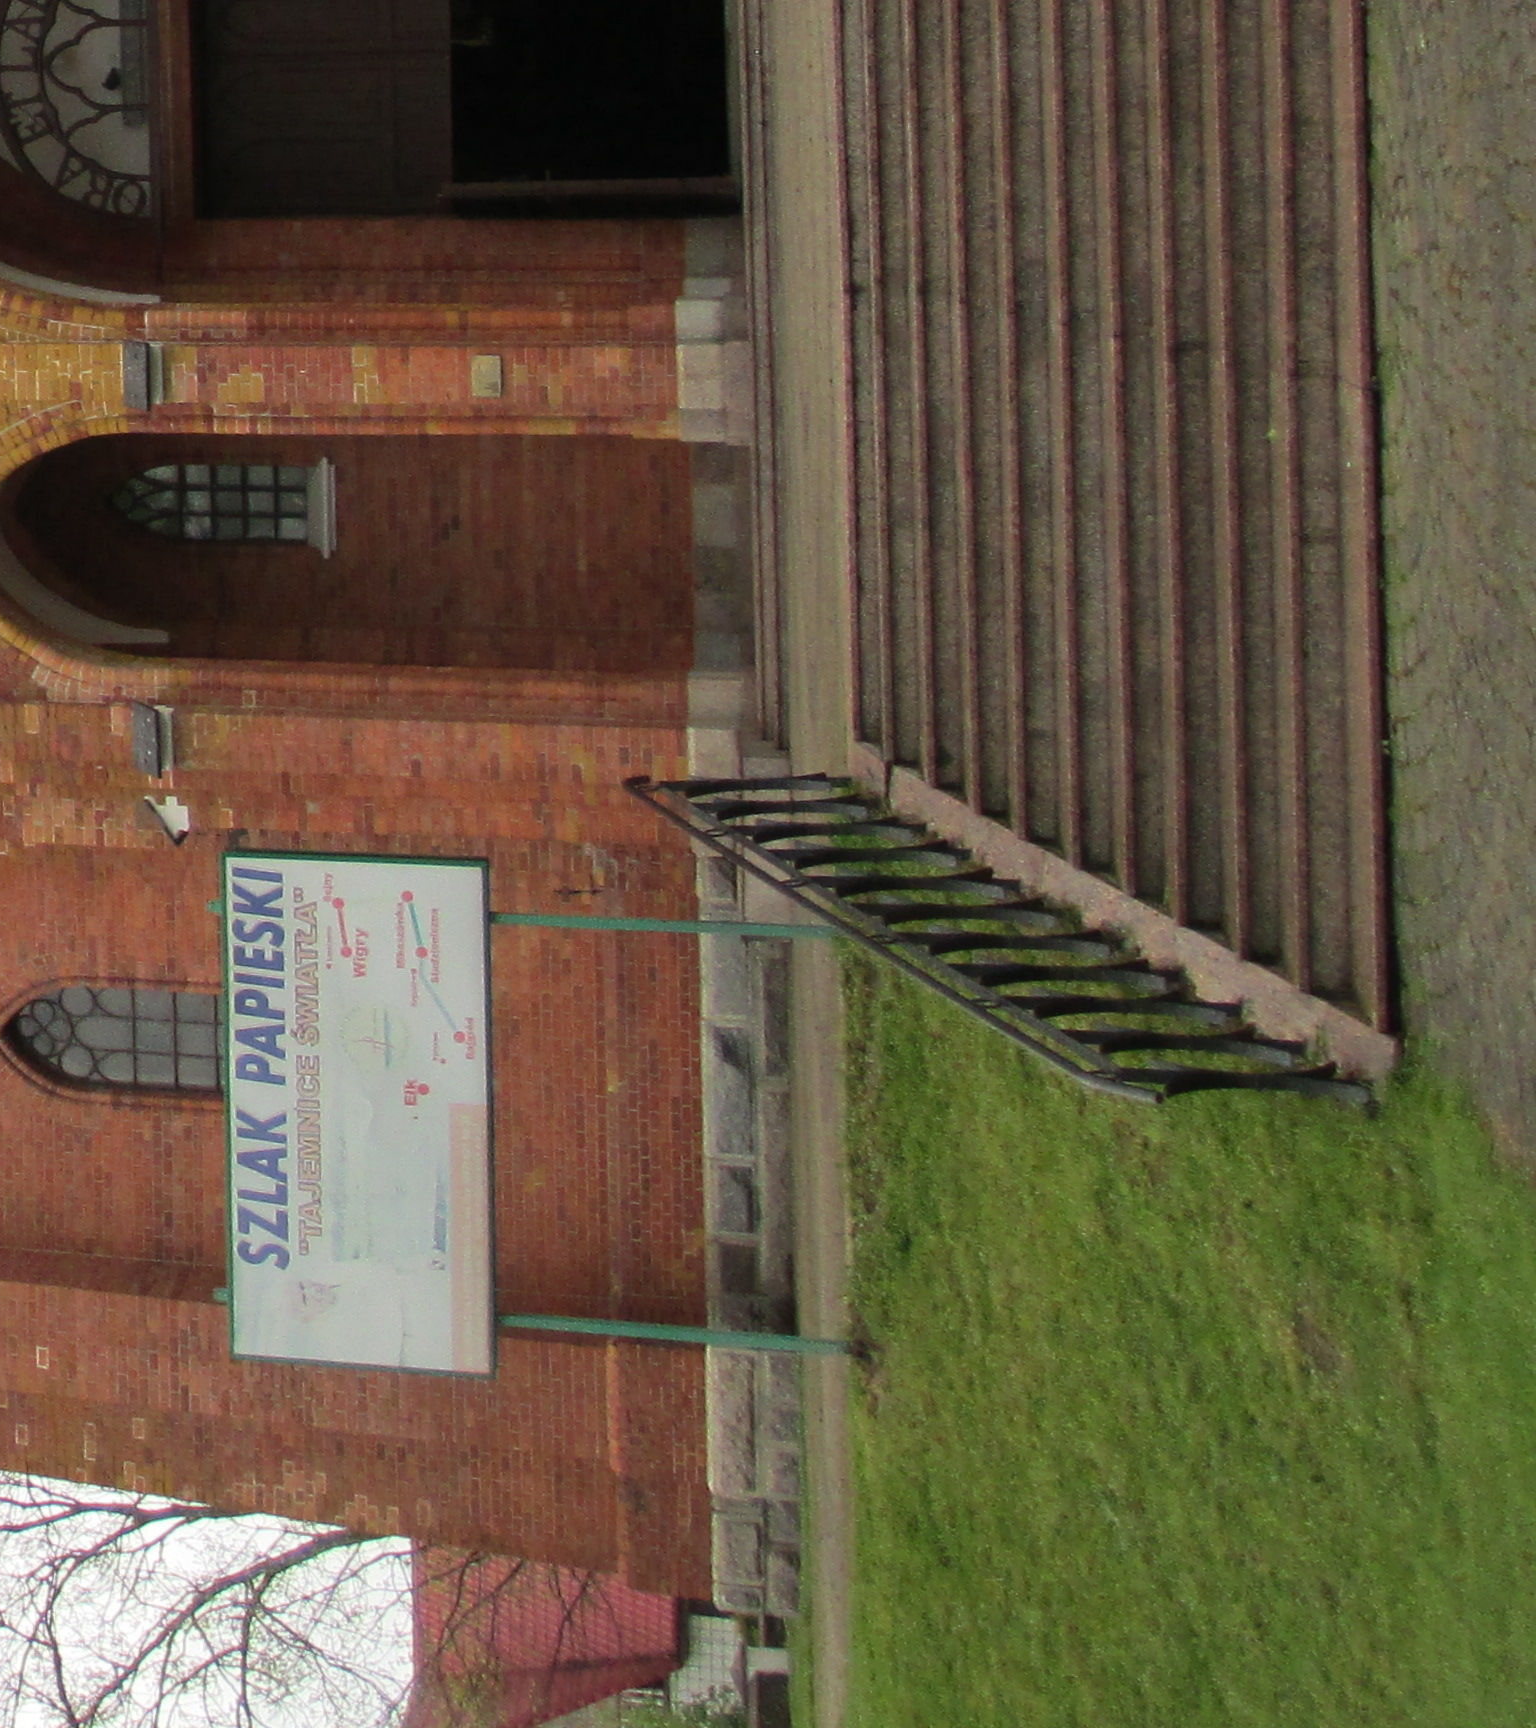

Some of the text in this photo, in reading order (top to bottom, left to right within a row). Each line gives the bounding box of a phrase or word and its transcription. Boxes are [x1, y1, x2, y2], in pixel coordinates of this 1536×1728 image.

[3, 91, 55, 145] ET
[55, 148, 147, 214] ORA
[353, 929, 369, 978] Wigry
[232, 867, 290, 1270] SZLAK PAPIESKI
